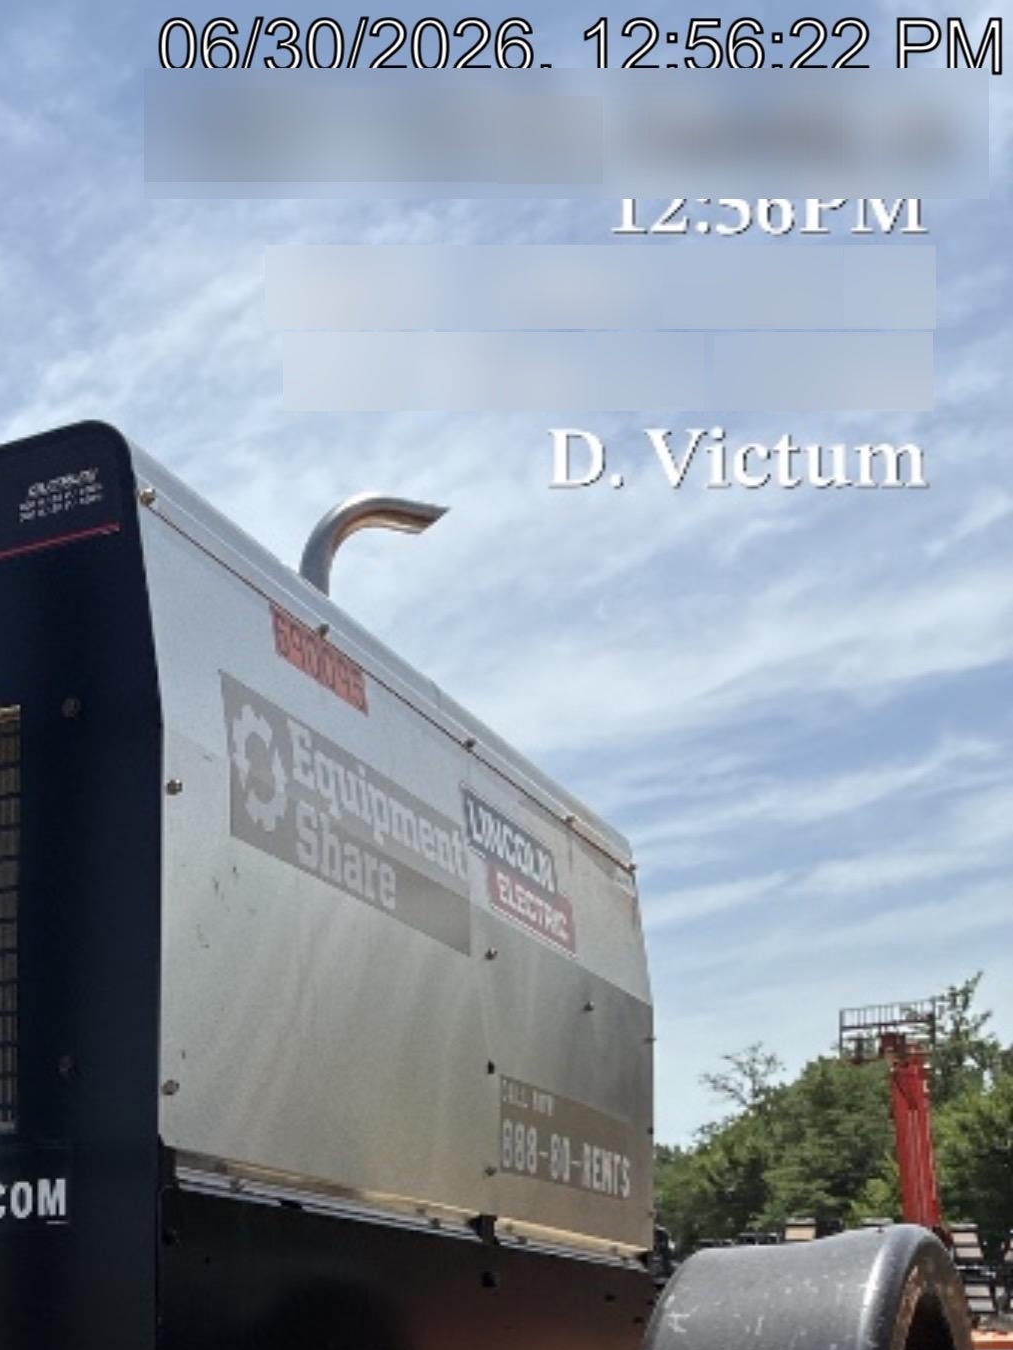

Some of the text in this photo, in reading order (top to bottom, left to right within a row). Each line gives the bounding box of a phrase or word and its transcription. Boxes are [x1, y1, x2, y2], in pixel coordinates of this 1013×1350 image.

[290, 720, 469, 880] Equipment
[466, 797, 556, 893] LINCOLN
[294, 803, 396, 910] Share
